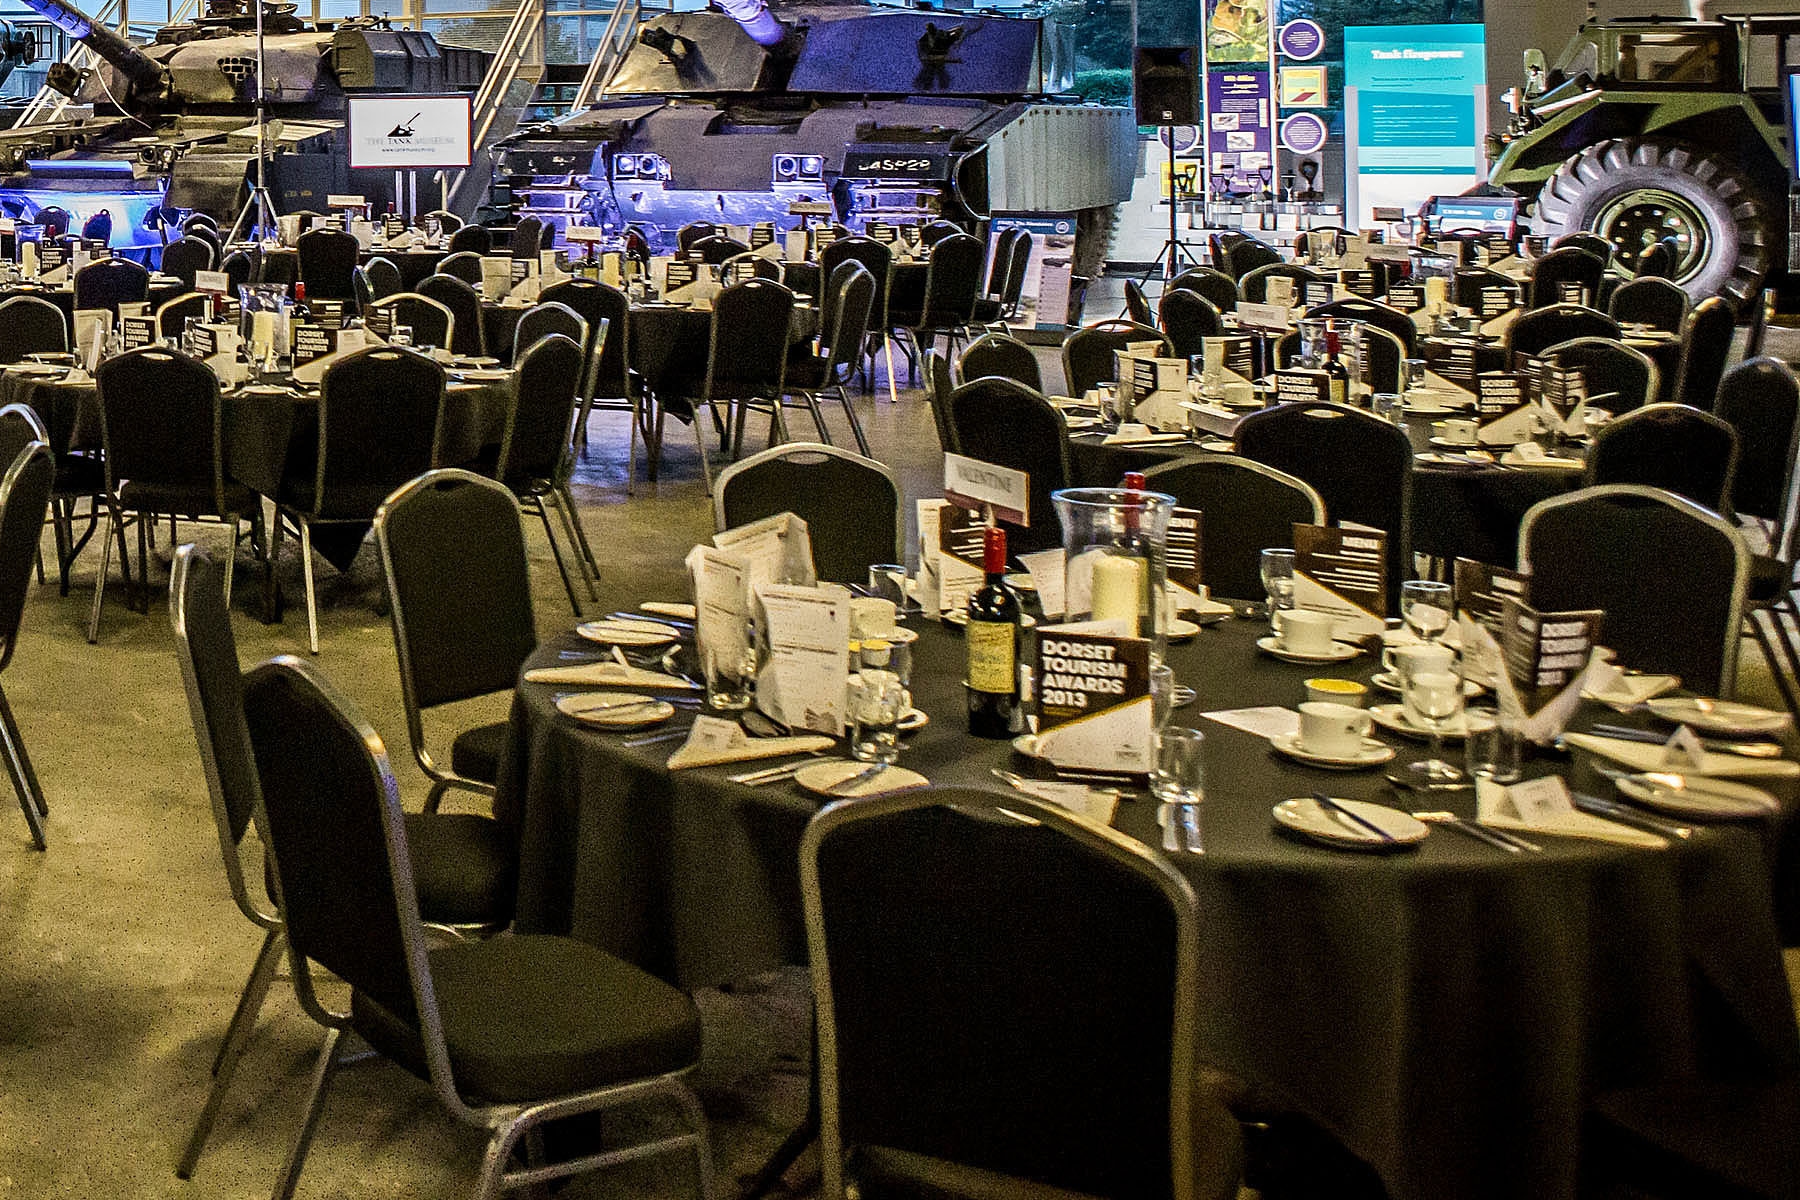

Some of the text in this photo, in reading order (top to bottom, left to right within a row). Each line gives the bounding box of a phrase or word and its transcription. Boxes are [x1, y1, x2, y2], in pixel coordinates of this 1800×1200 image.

[1278, 376, 1313, 385] DORSET
[1278, 384, 1319, 393] TOURISM
[1480, 379, 1516, 388] DORSET
[1342, 536, 1381, 550] MENU
[1042, 640, 1116, 660] DORSET
[1042, 656, 1128, 678] TOURISM
[1042, 674, 1126, 694] AWARDS
[1042, 690, 1088, 708] 2013
